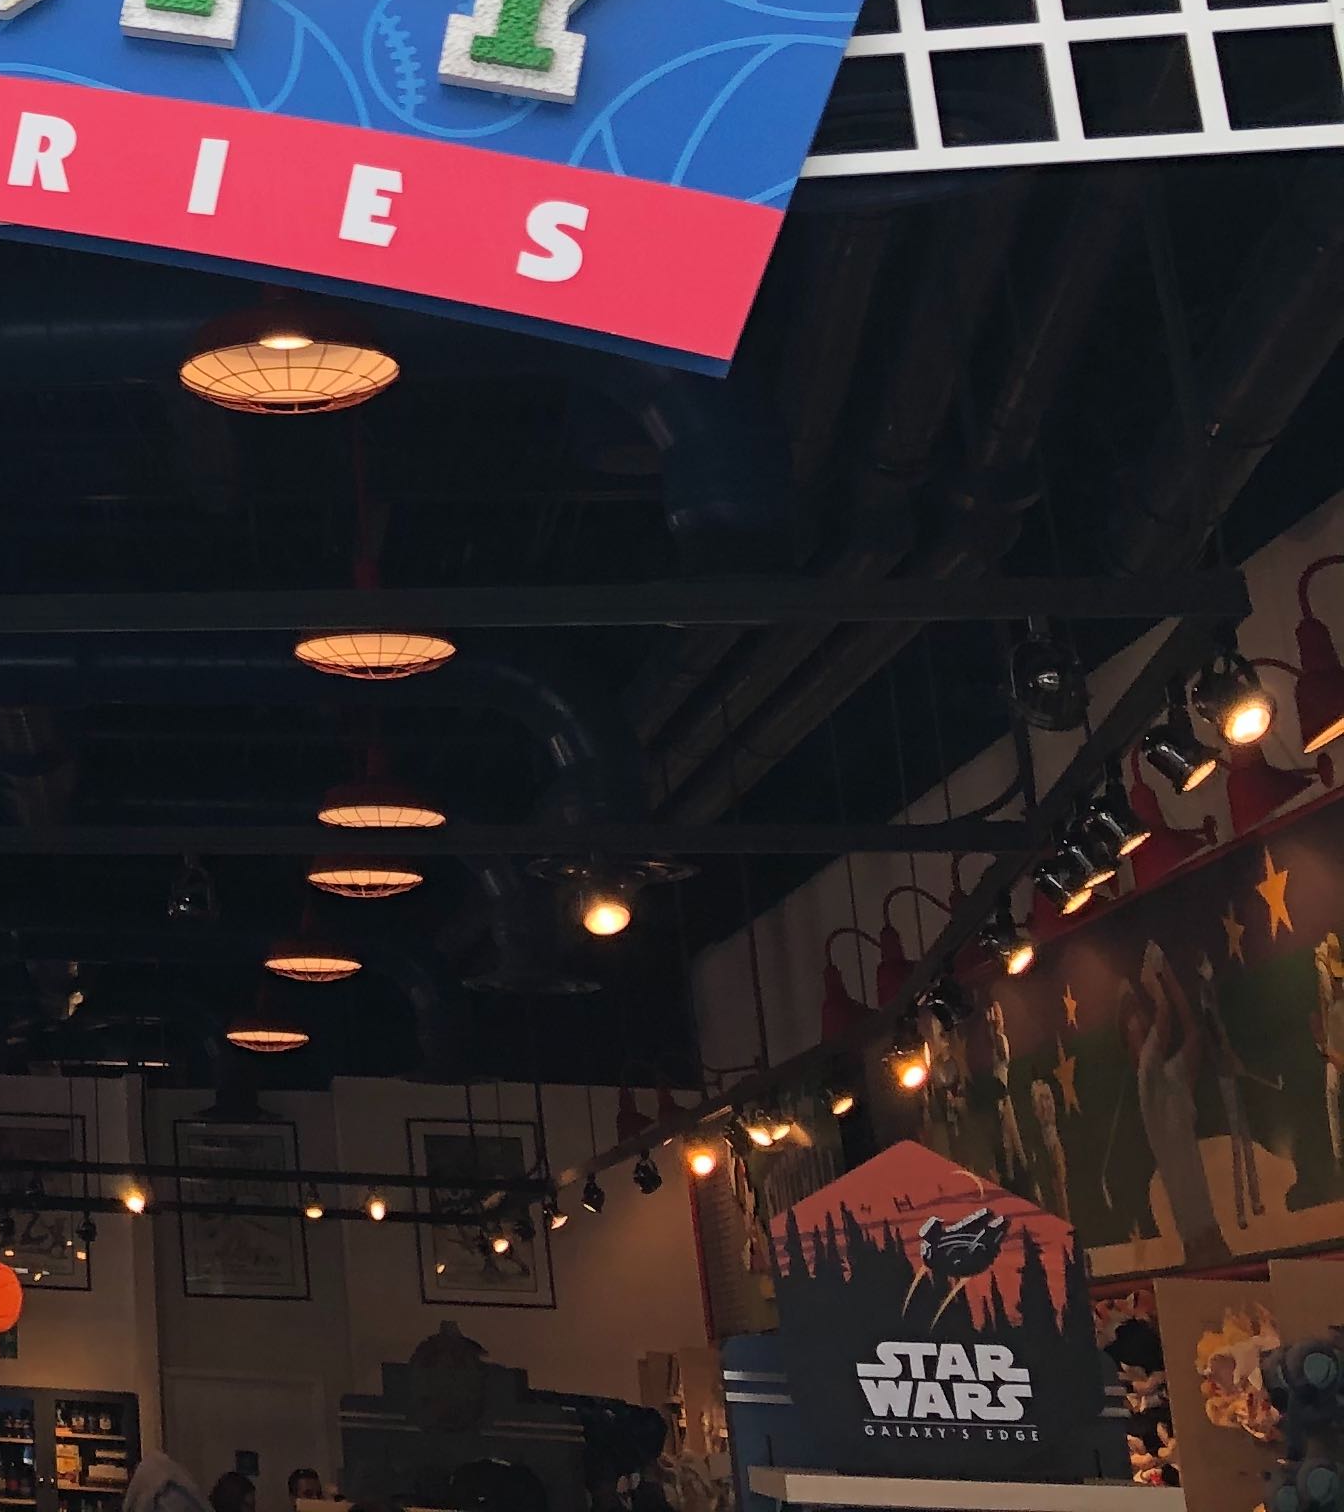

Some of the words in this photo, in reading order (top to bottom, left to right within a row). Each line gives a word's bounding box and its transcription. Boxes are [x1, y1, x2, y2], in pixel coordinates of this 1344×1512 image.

[857, 1341, 1030, 1382] STAR
[858, 1378, 1033, 1422] WARS
[864, 1424, 970, 1439] GALAXY'S
[986, 1429, 1040, 1442] EDGE
